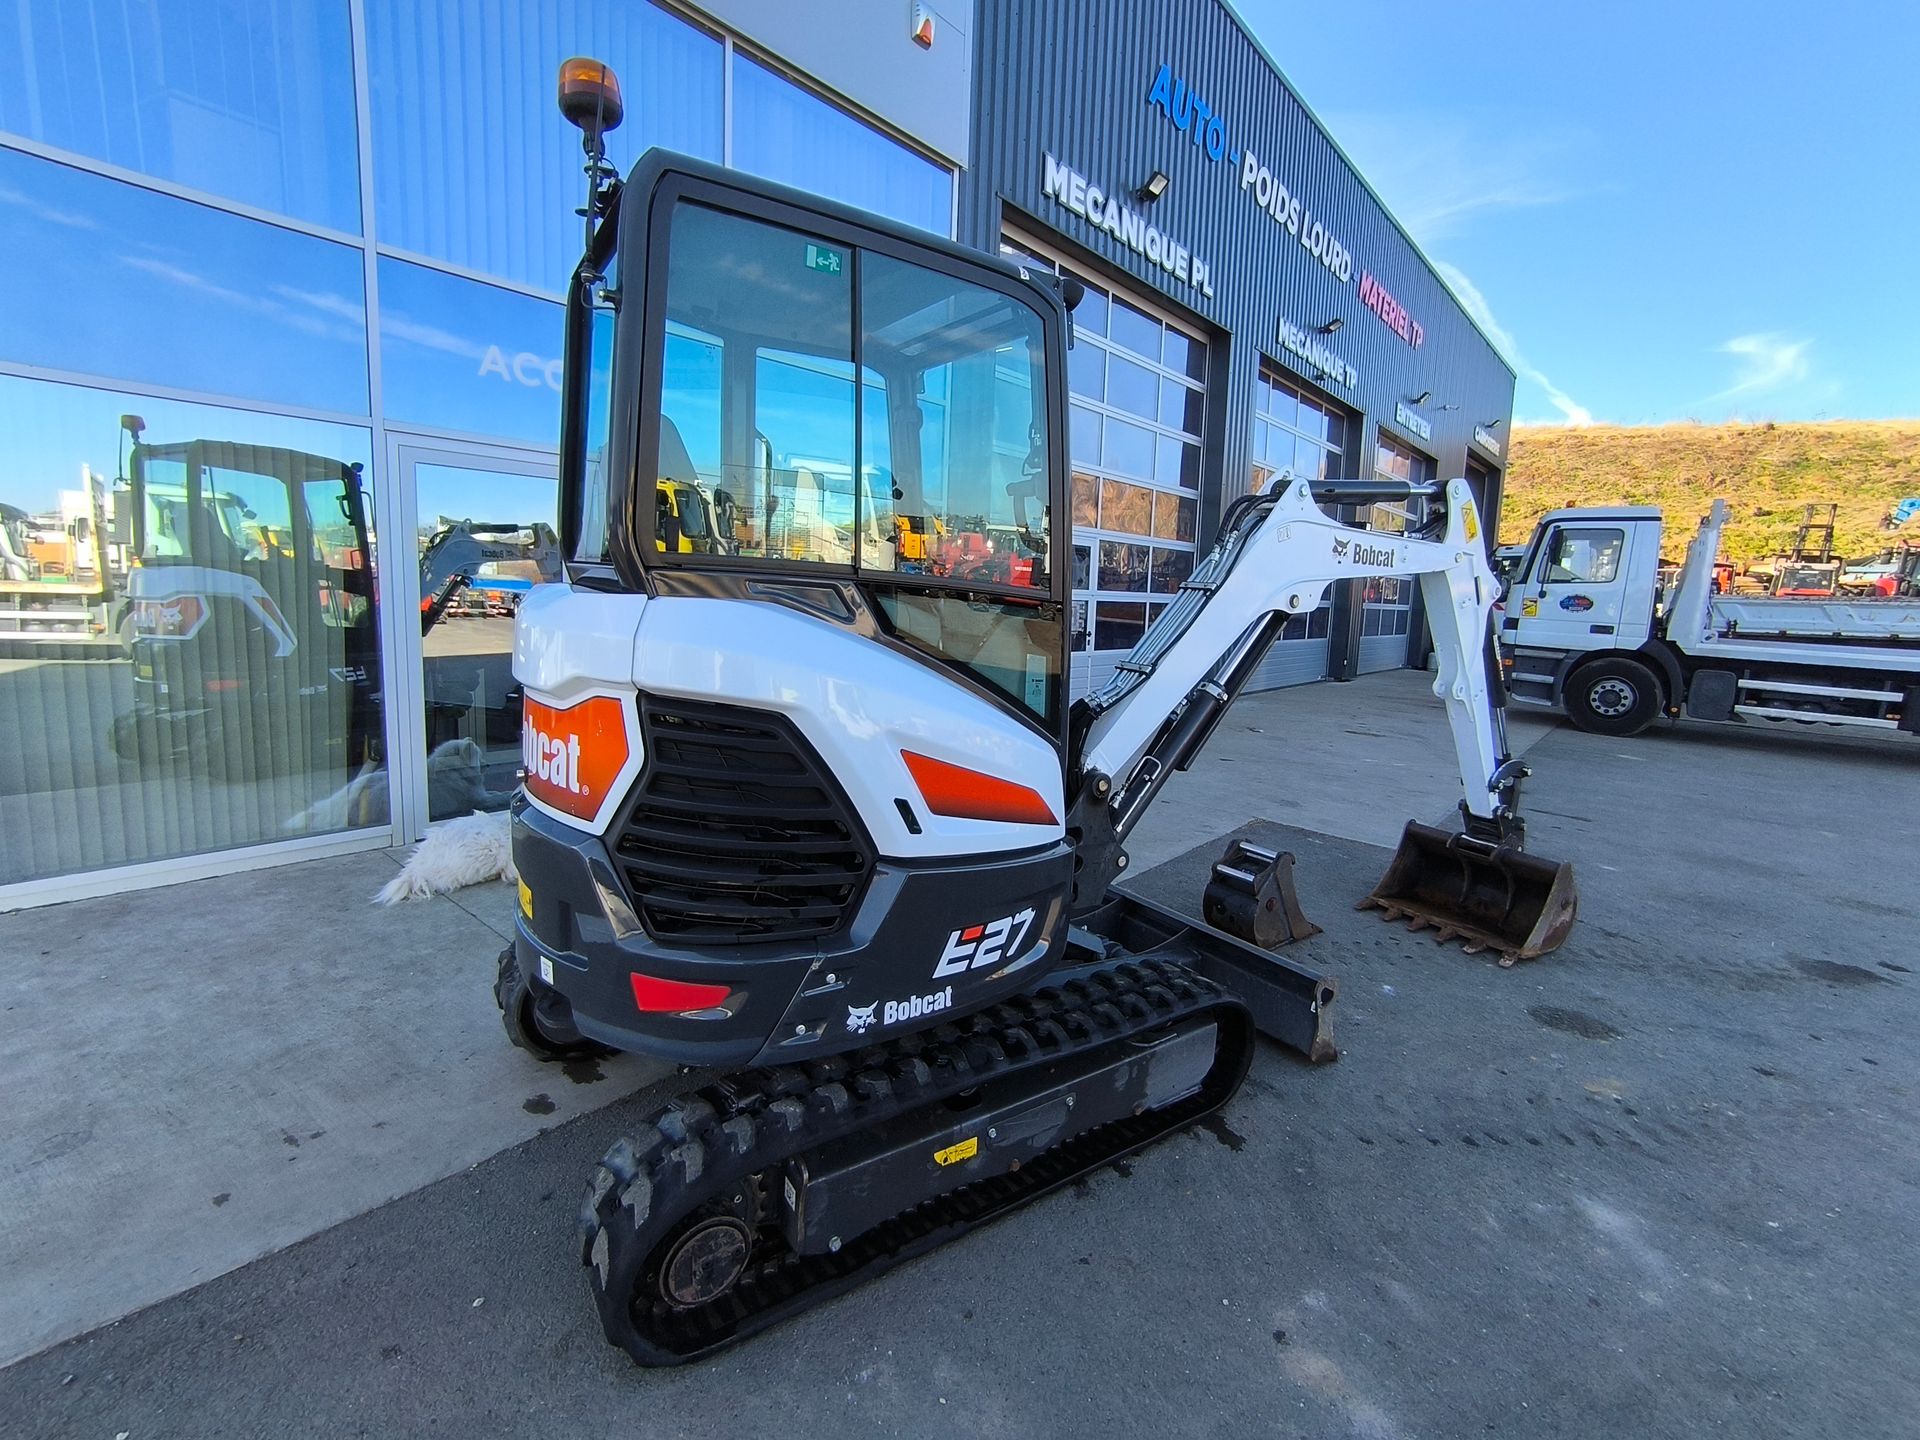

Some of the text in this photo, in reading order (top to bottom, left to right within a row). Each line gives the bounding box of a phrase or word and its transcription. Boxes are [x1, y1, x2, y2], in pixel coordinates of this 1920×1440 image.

[1043, 151, 1214, 299] MECANIQUE PL
[1149, 63, 1225, 161] AUTO
[1241, 150, 1301, 236] POIDS
[1301, 210, 1351, 282] LOURD
[1358, 268, 1410, 342] MATERIEL
[1410, 319, 1424, 351] TP
[1276, 315, 1358, 391] MECANIQUE TP
[1353, 543, 1395, 569] Bobcat
[523, 713, 581, 794] obcat
[932, 906, 1036, 979] E27
[884, 986, 953, 1025] Bobcat
